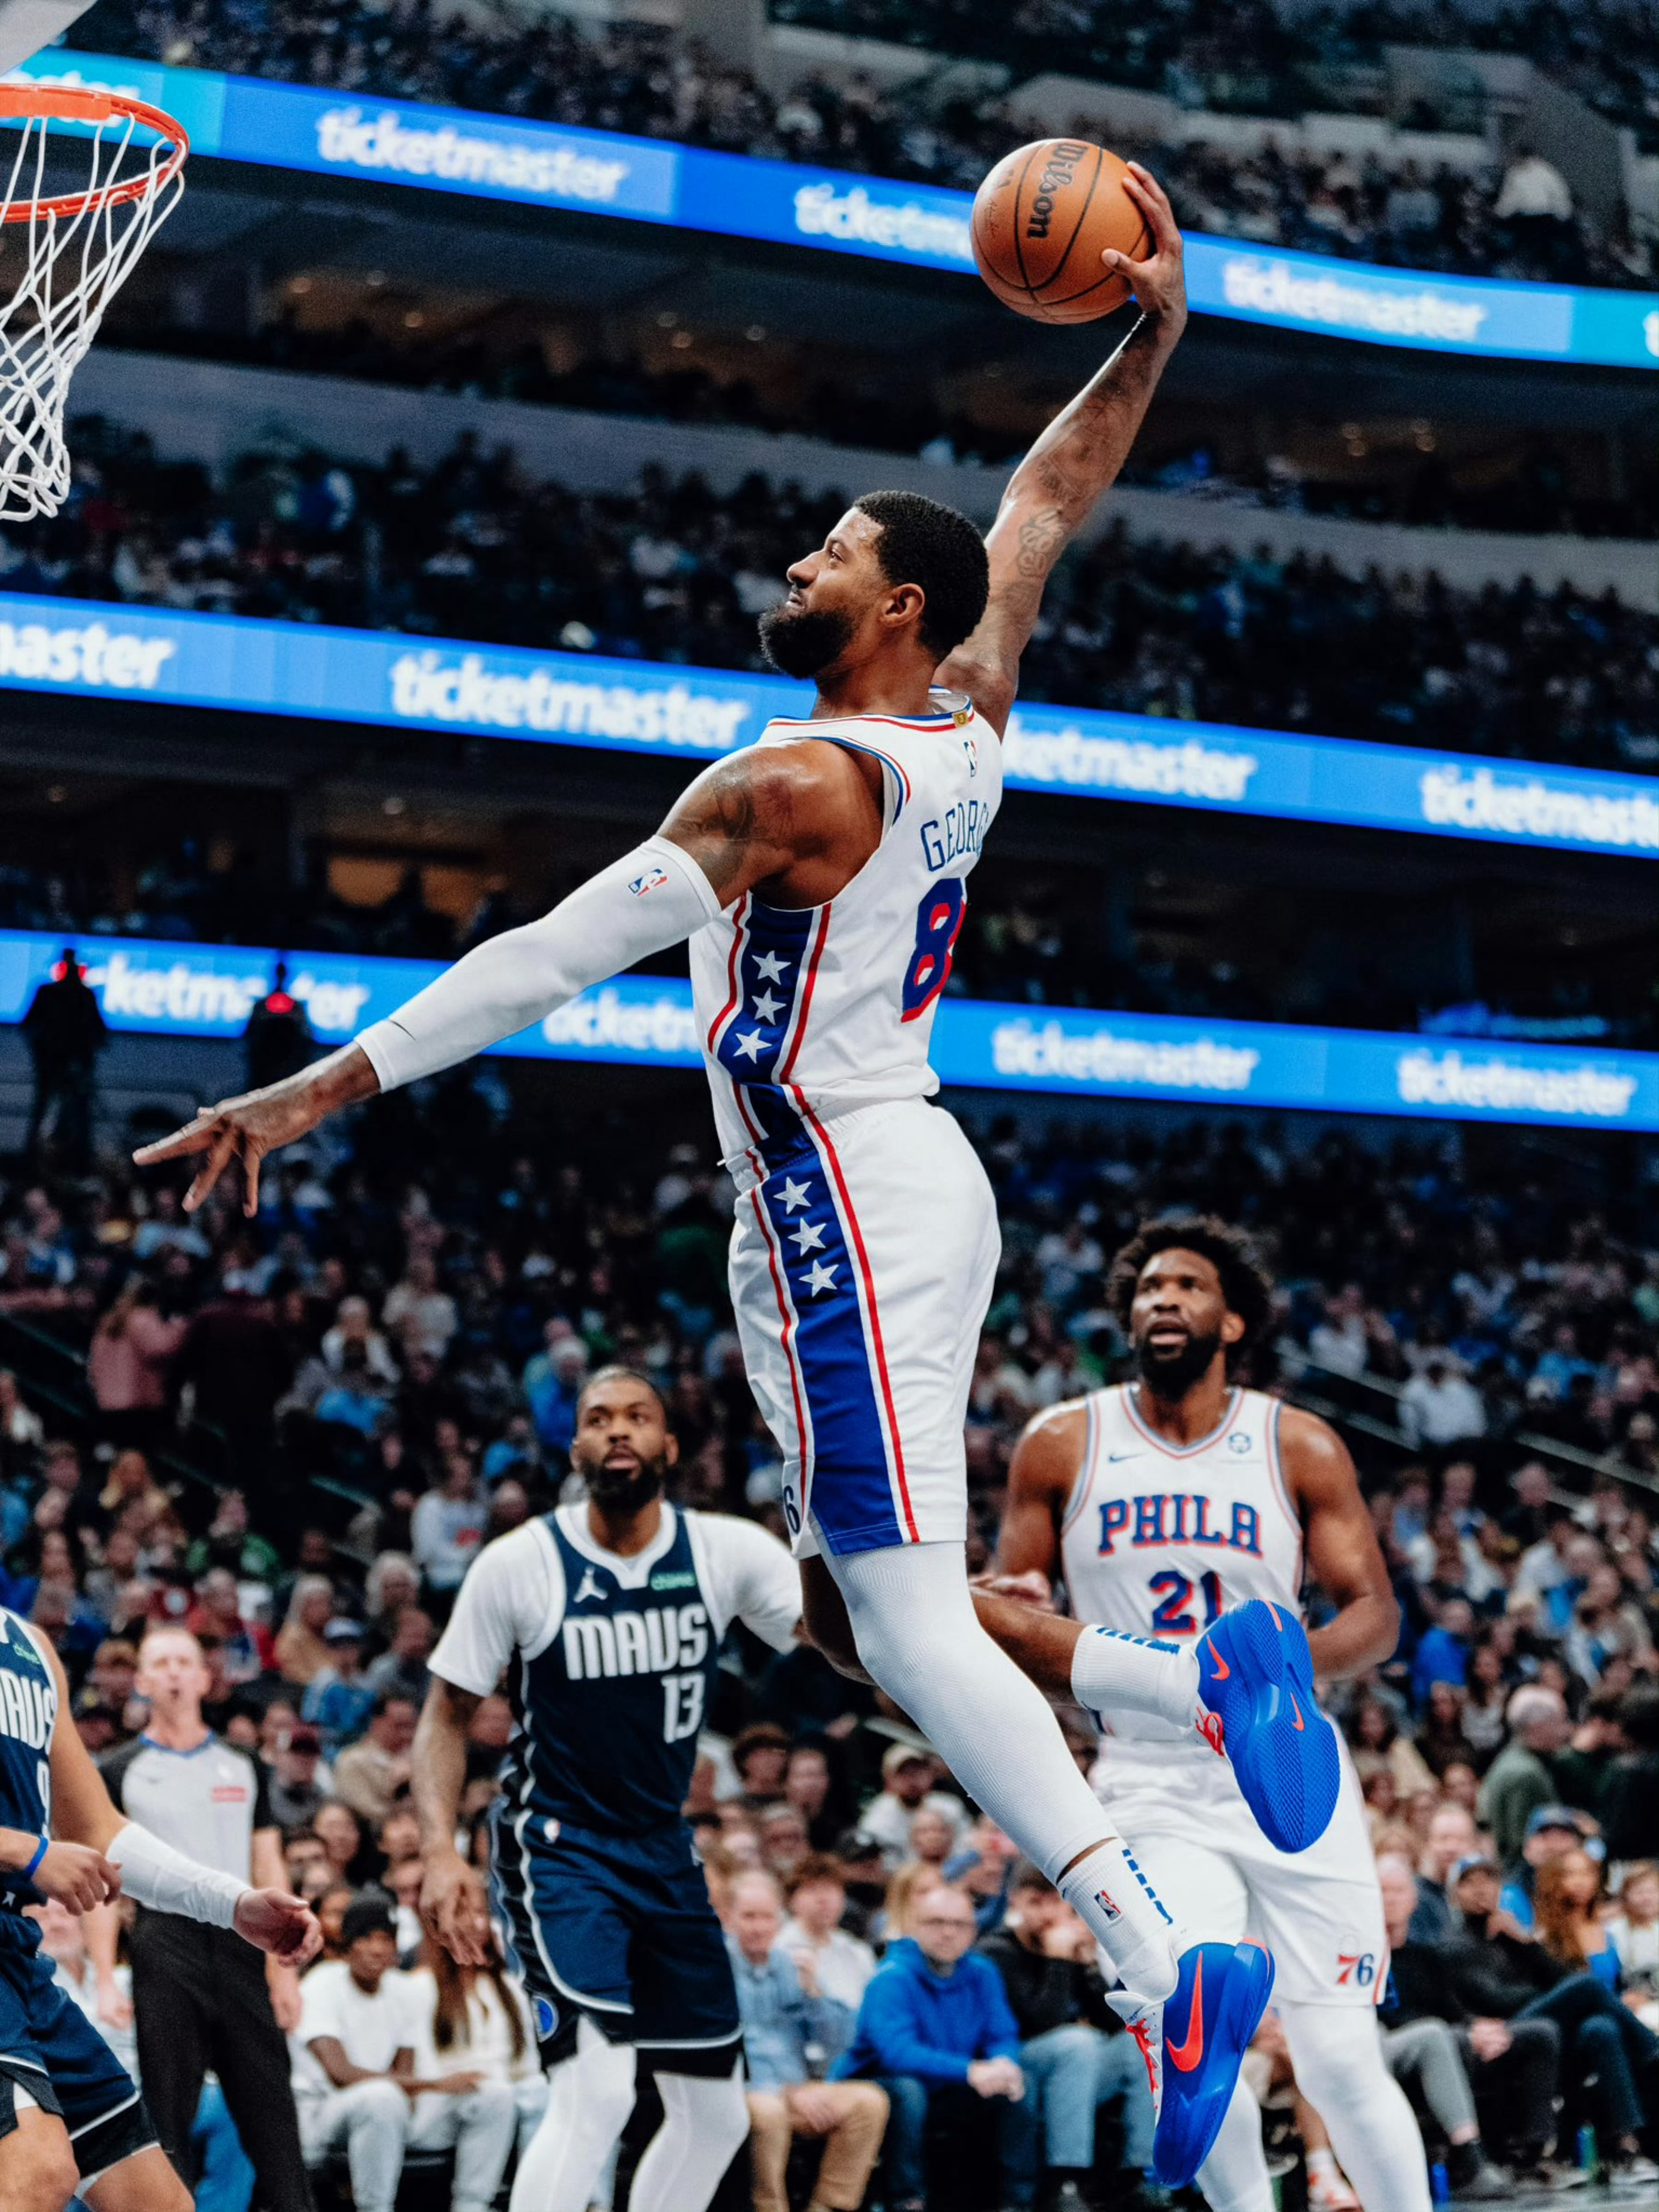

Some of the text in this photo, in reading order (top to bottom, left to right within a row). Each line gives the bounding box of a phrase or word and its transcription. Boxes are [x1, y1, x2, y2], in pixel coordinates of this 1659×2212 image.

[318, 112, 629, 200] ticketmaster
[1027, 143, 1088, 238] Wilson
[391, 651, 746, 747] ticketmaster
[901, 877, 967, 1023] 8
[1098, 1494, 1264, 1560] PHILA
[1148, 1571, 1222, 1636] 21
[660, 1670, 706, 1744] 13
[1335, 1953, 1374, 1987] 76
